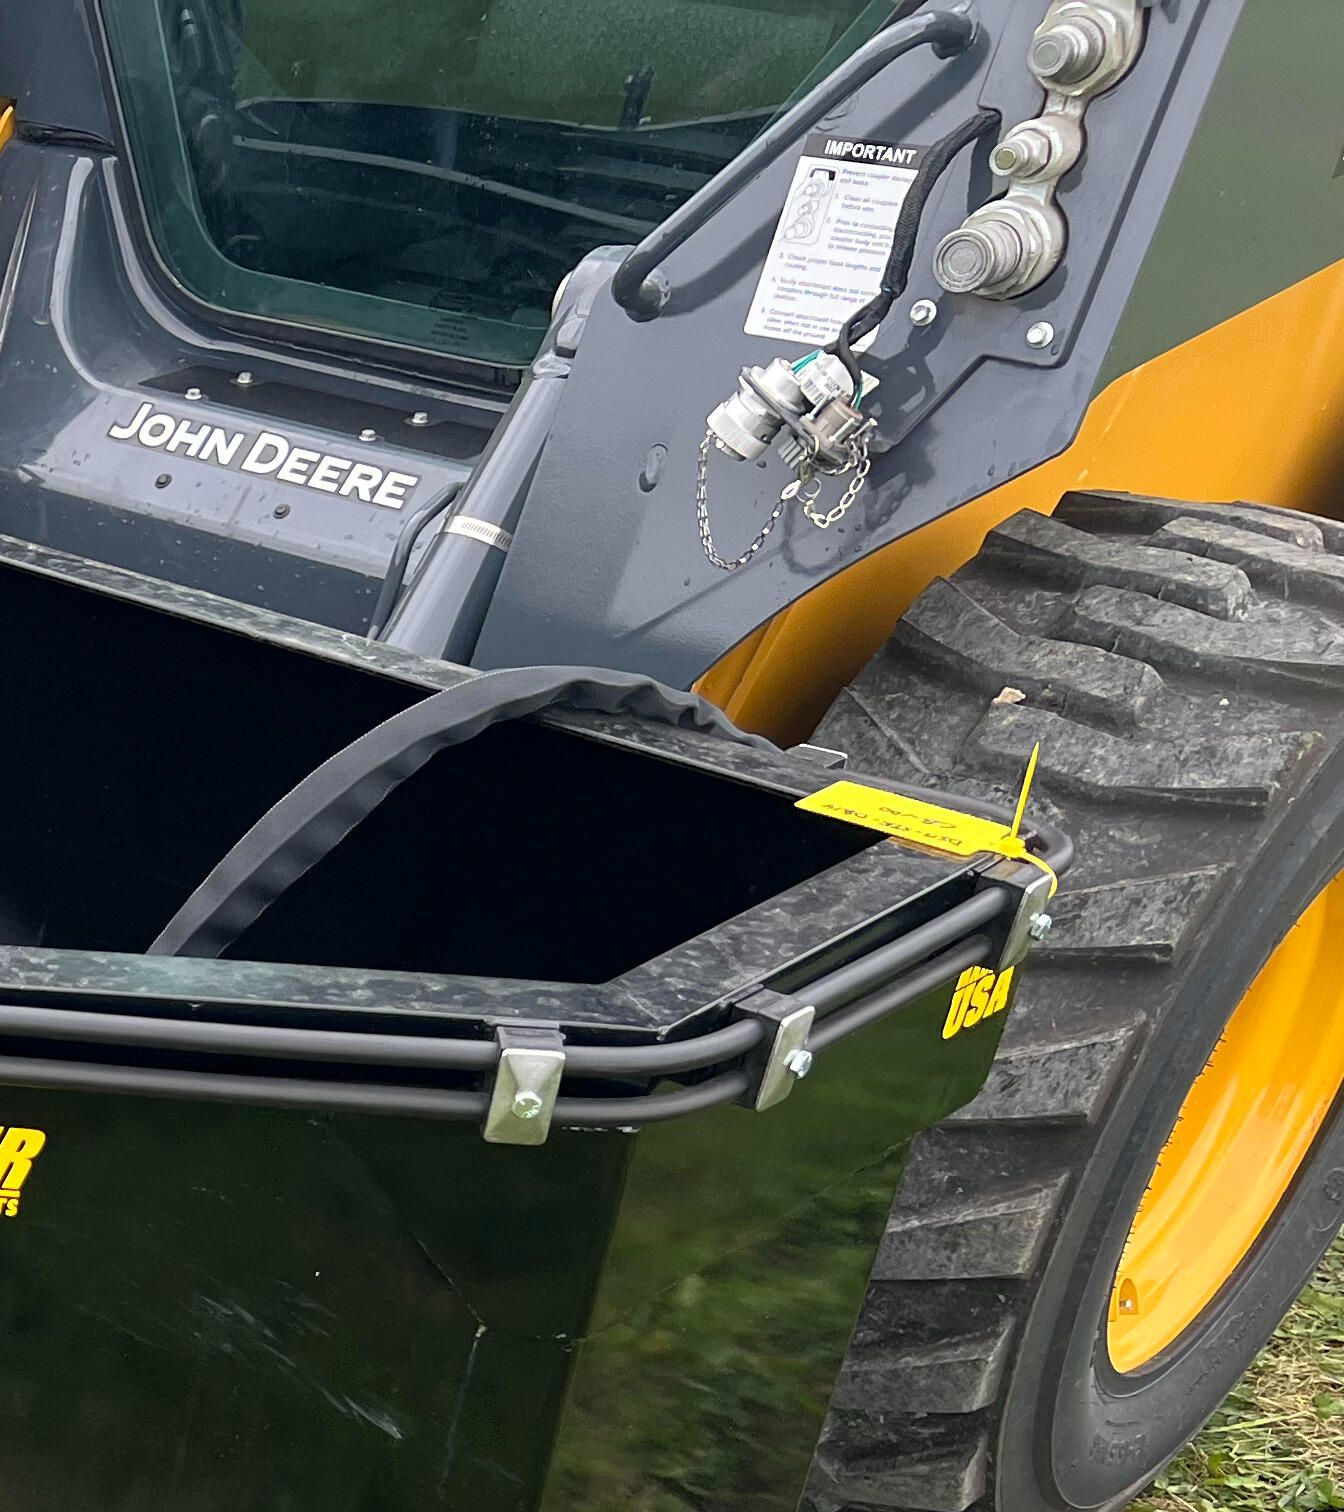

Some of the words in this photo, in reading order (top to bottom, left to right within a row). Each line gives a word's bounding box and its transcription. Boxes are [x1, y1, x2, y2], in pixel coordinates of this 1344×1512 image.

[824, 139, 917, 164] IMPORTANT
[108, 402, 245, 466] JOHN
[241, 431, 420, 511] DEERE
[942, 965, 1015, 1040] USA
